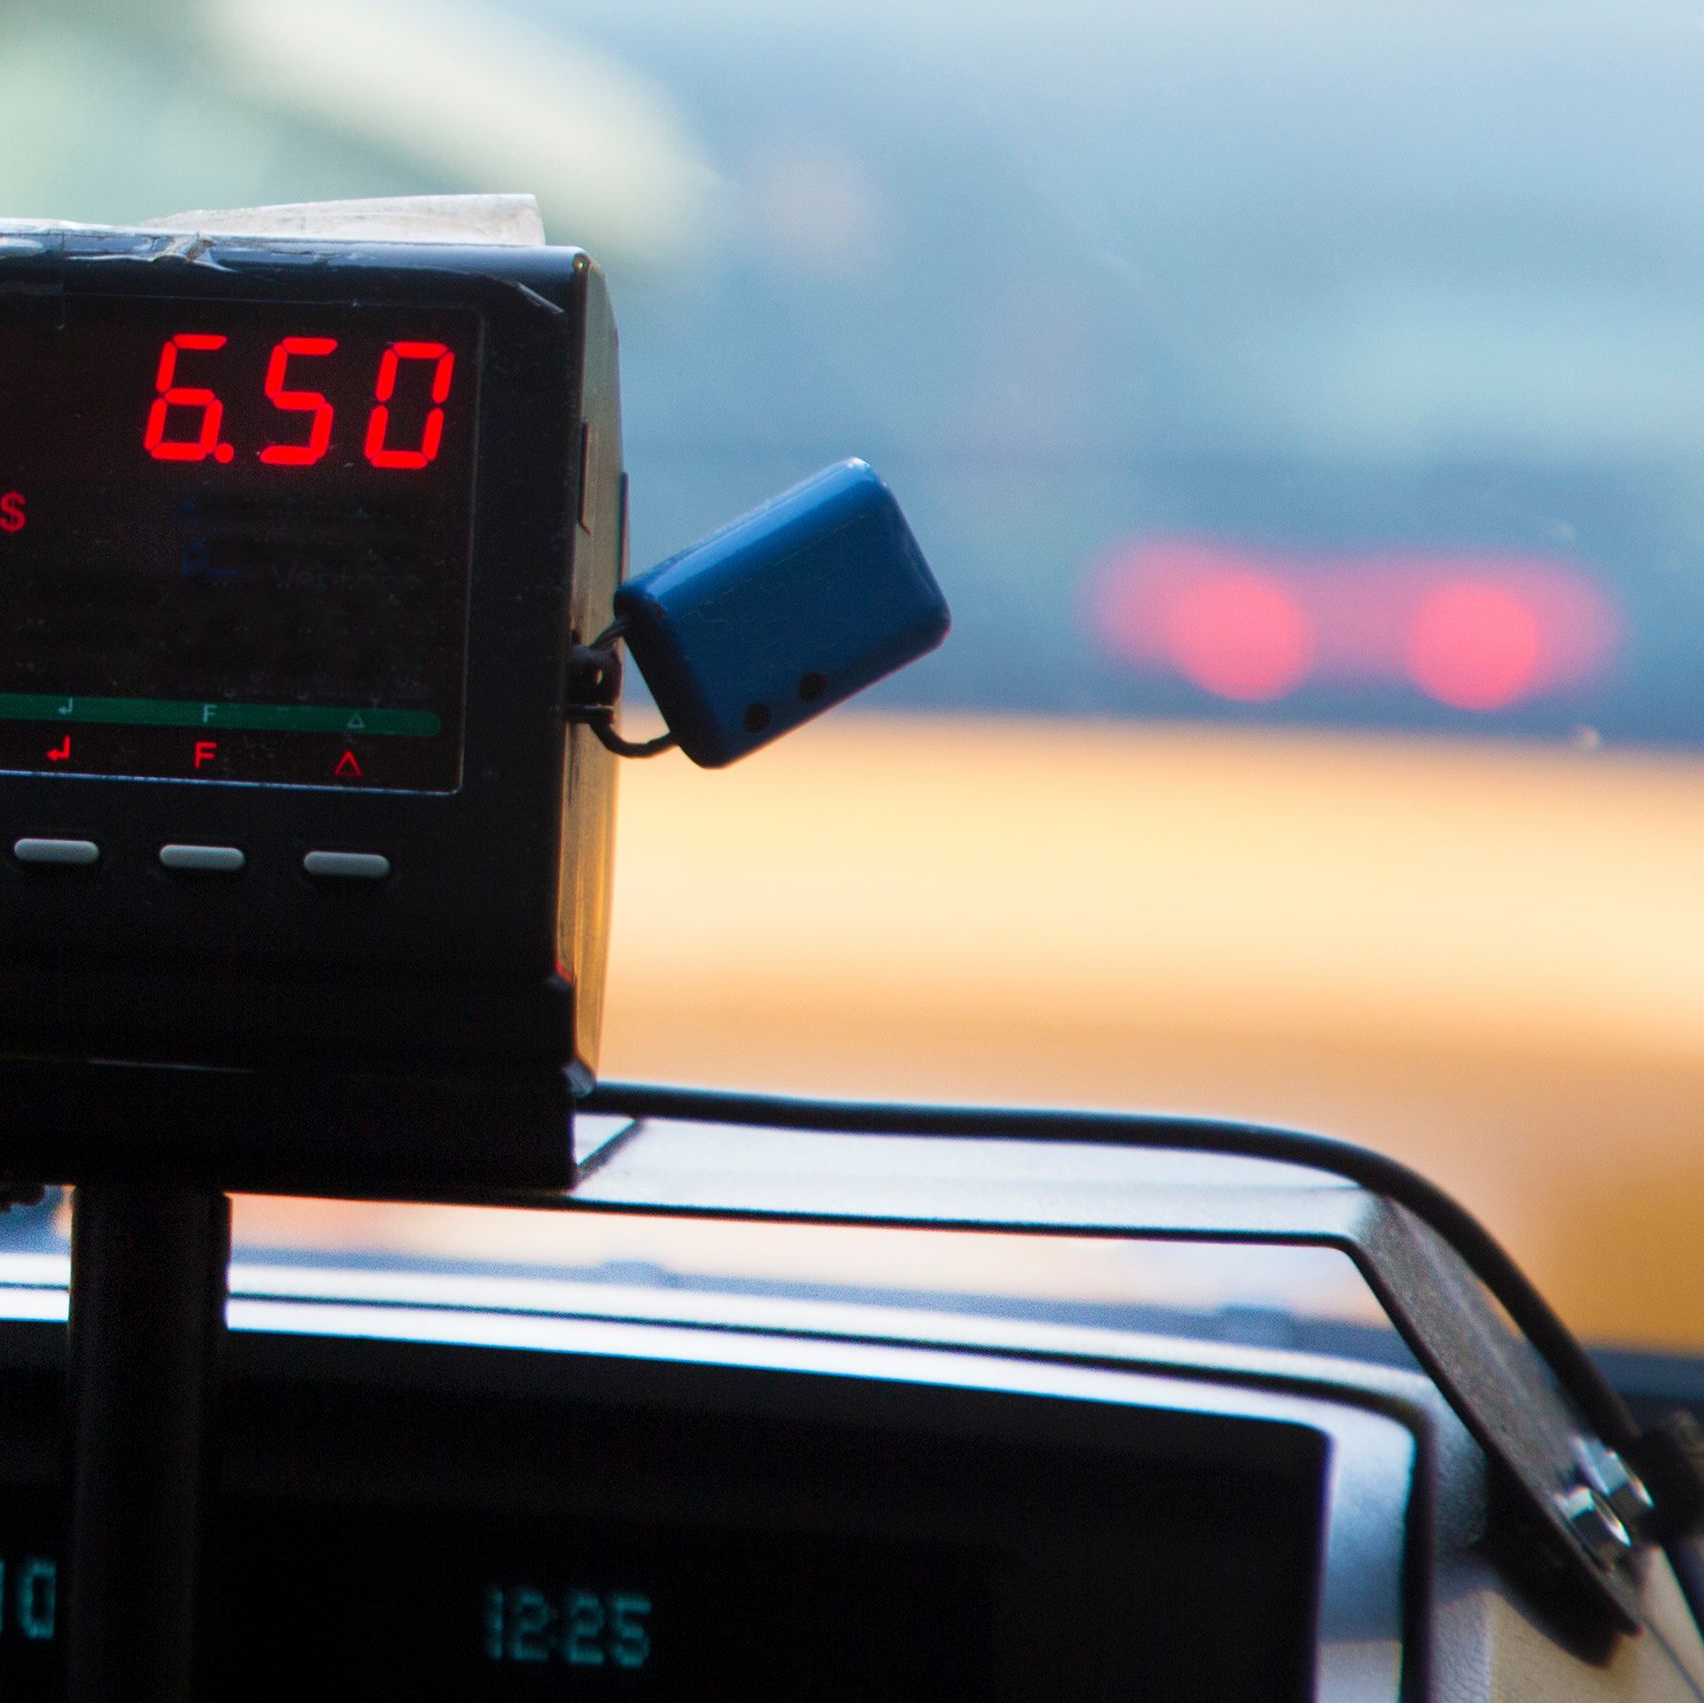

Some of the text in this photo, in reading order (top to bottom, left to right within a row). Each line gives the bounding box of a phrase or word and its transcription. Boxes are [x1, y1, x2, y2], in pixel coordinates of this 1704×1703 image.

[144, 333, 455, 470] 6.50
[202, 704, 218, 724] F
[194, 741, 218, 769] F
